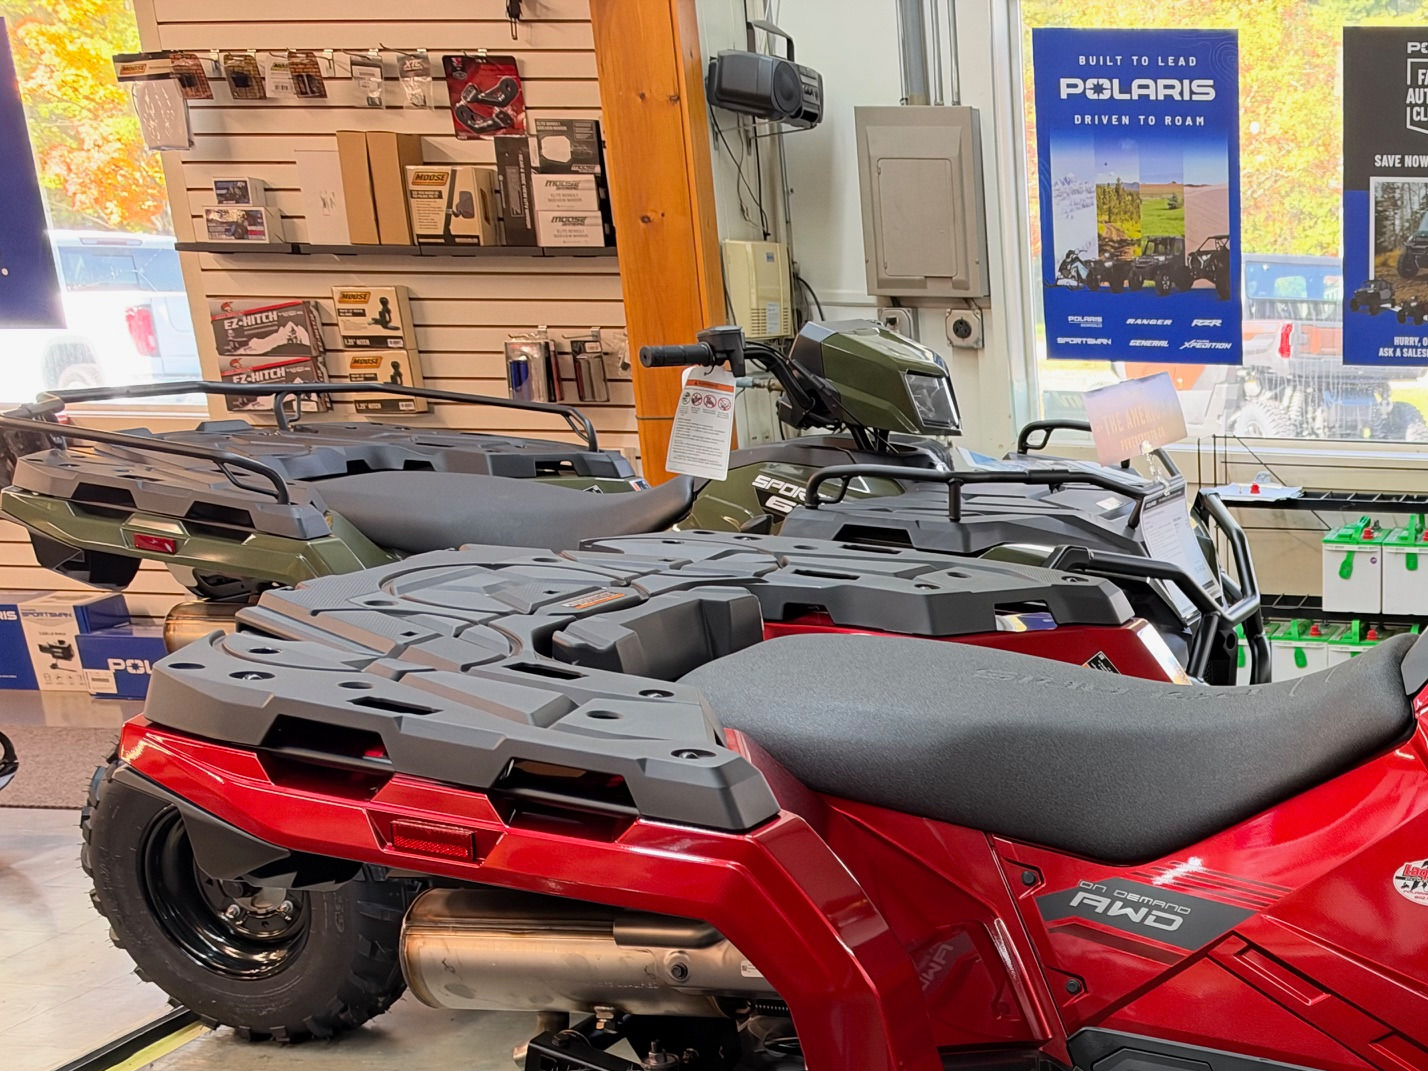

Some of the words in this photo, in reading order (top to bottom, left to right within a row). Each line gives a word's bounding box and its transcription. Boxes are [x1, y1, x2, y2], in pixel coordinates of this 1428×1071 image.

[1078, 55, 1122, 66] BUILT
[1132, 56, 1149, 66] TO
[1158, 56, 1197, 67] LEAD
[1060, 77, 1216, 101] POLARIS
[1074, 115, 1130, 125] DRIVEN
[1138, 116, 1156, 125] TO
[1165, 116, 1205, 126] ROAM
[1374, 155, 1402, 167] SAVE
[415, 173, 446, 182] MOOSE
[1068, 315, 1102, 323] POLARIS
[1191, 319, 1222, 327] RZR
[1057, 337, 1111, 345] SPORTSMAN
[1129, 339, 1169, 347] GENERAL
[1179, 339, 1232, 350] XPEDITION
[1394, 336, 1421, 347] HURRY,
[1379, 348, 1394, 357] ASK
[1395, 348, 1402, 357] A
[353, 357, 381, 365] MOOSE
[1078, 880, 1107, 893] ON
[1114, 889, 1192, 915] DEMAND
[1069, 891, 1184, 931] AWD
